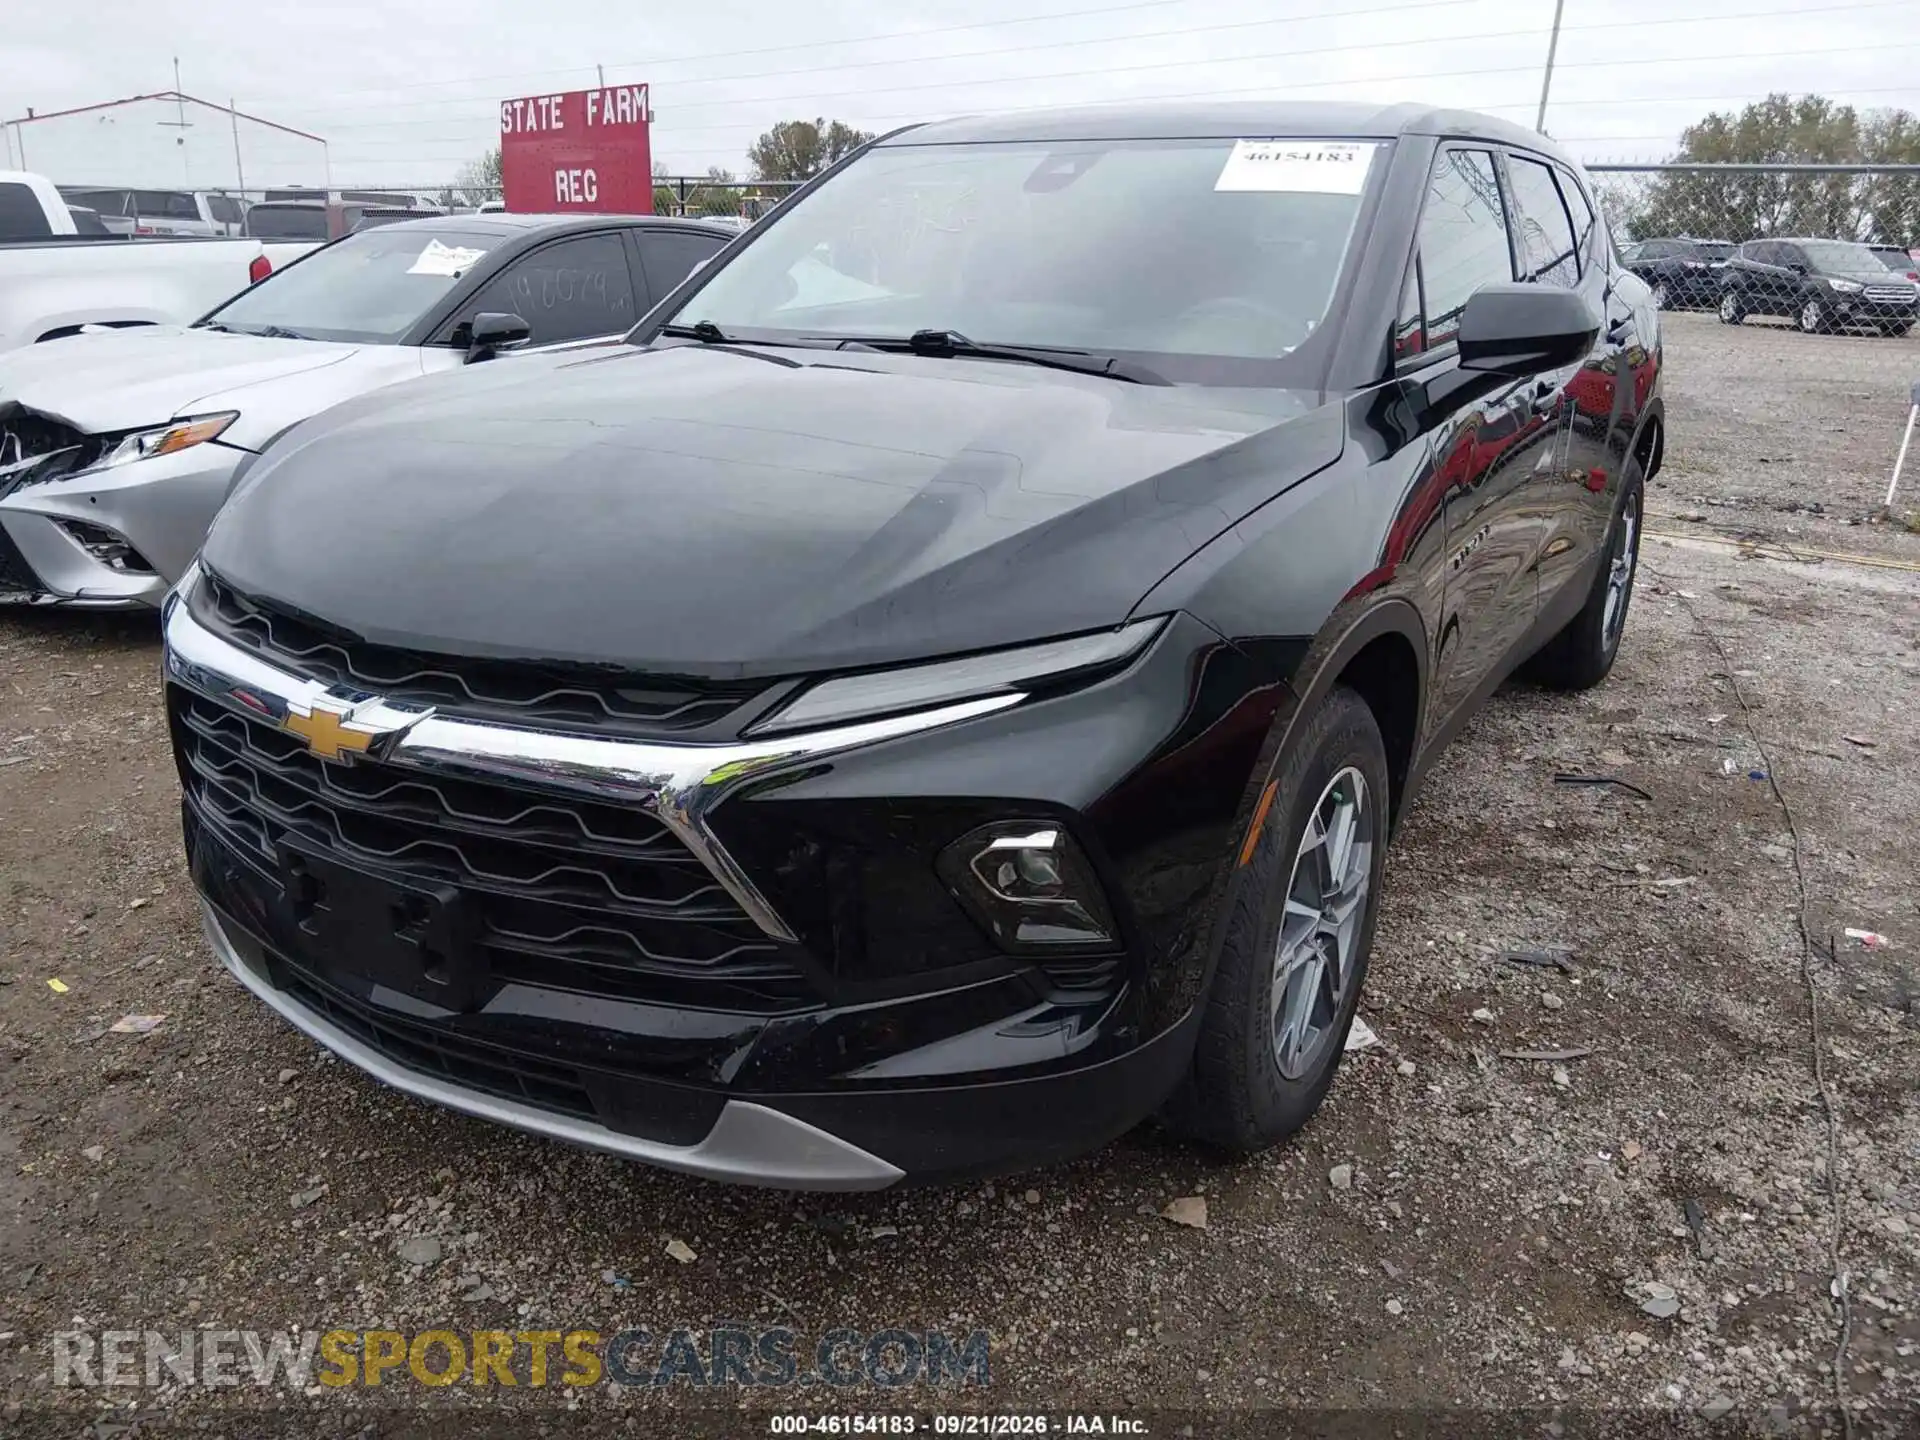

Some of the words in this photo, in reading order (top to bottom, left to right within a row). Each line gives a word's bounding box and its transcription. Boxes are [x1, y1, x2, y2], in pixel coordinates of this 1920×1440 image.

[502, 96, 564, 133] STATE
[587, 86, 647, 126] FARM
[1244, 151, 1354, 162] 46154183
